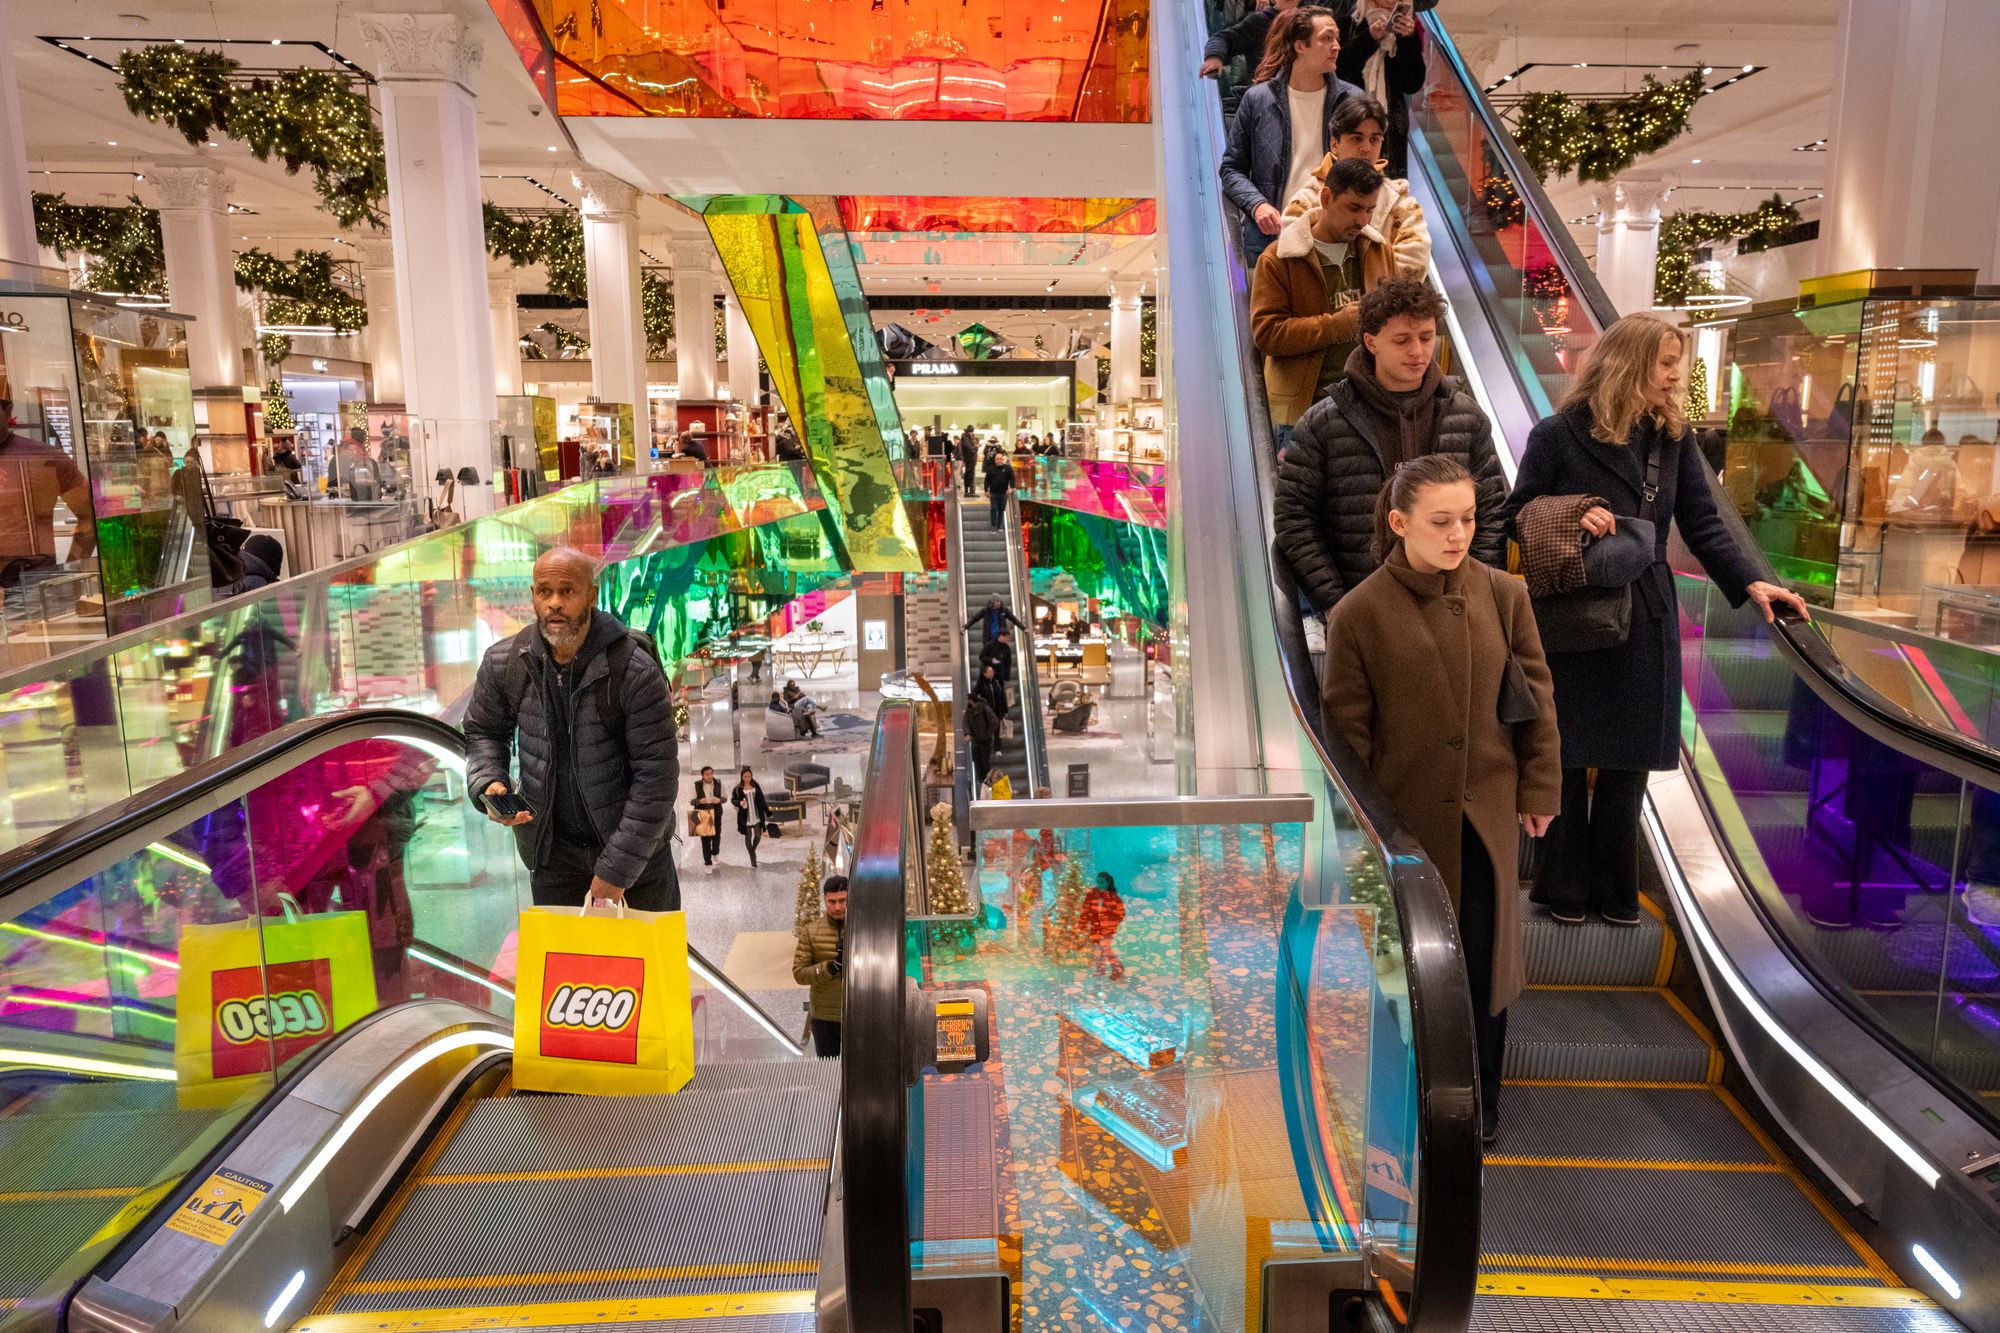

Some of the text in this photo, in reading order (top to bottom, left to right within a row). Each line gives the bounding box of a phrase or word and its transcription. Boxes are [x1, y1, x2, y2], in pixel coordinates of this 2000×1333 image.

[912, 363, 958, 374] PRADA
[546, 984, 637, 1031] LEGO
[937, 1019, 974, 1032] EMERGENCY
[947, 1032, 965, 1046] STOP
[224, 1172, 267, 1190] CAUTION
[169, 1222, 211, 1240] Avoid Sides
[175, 1218, 227, 1239] Attend Children
[179, 1213, 226, 1232] Hold Handrail
